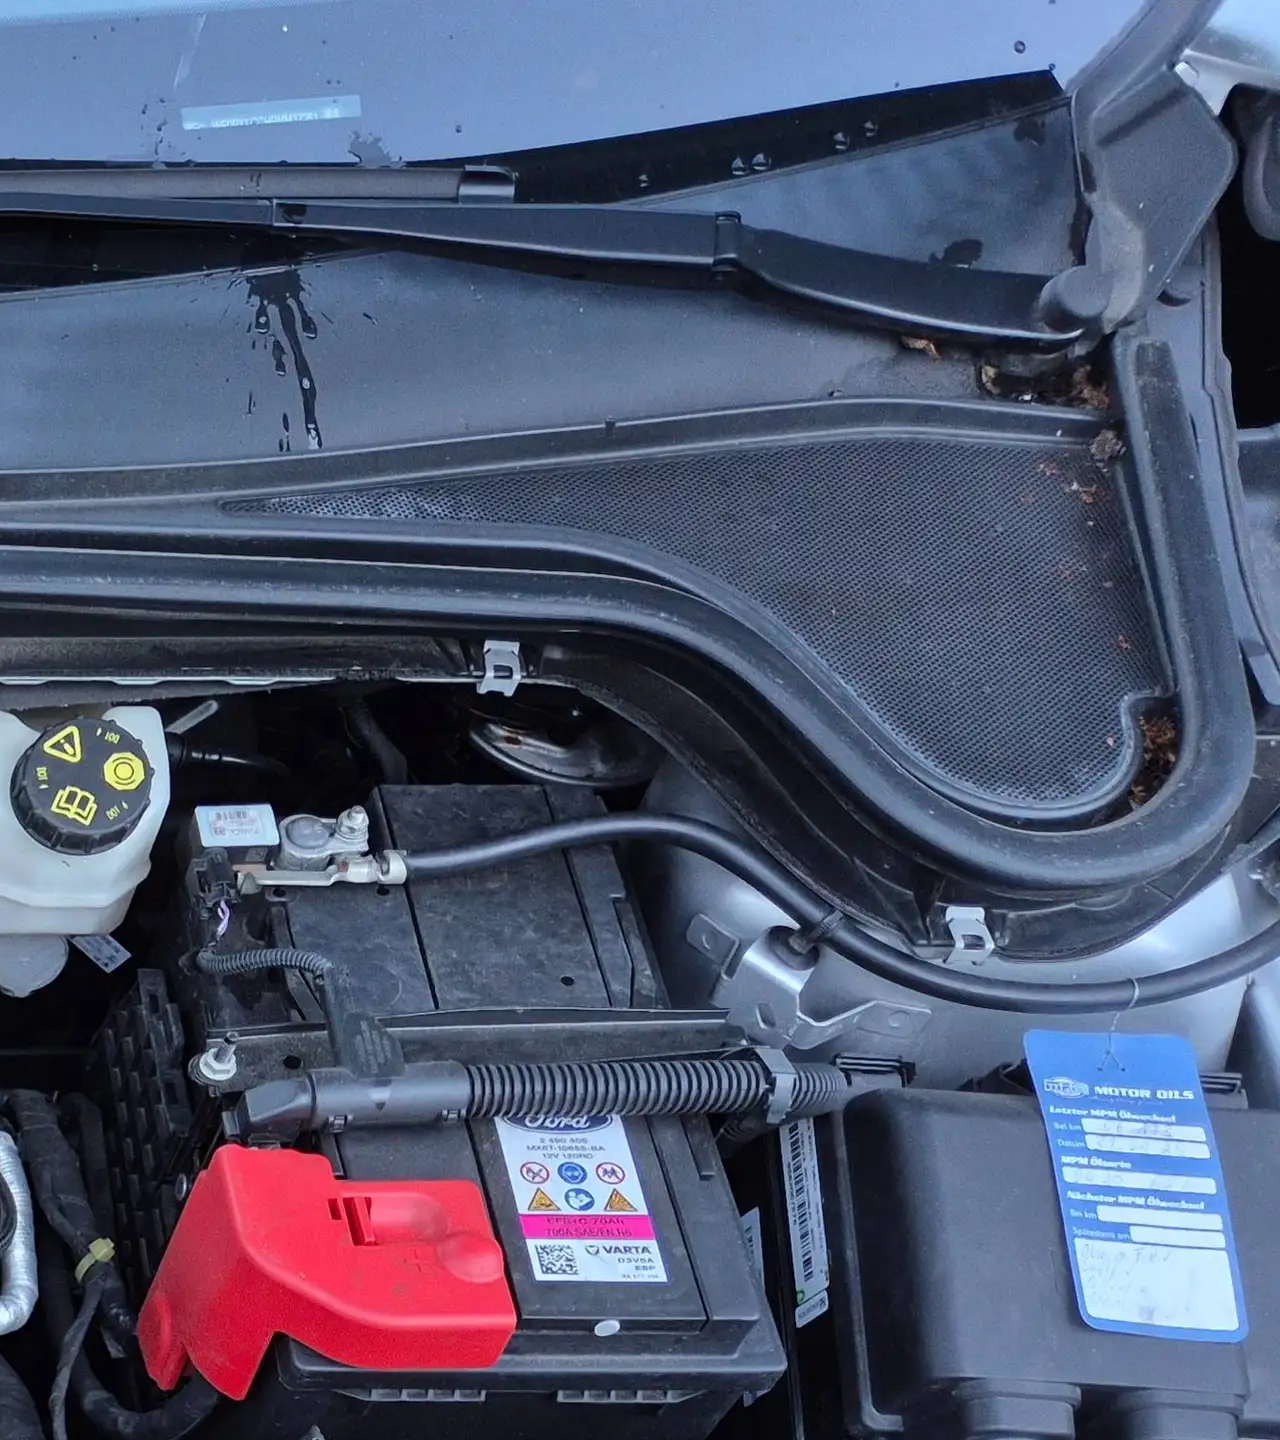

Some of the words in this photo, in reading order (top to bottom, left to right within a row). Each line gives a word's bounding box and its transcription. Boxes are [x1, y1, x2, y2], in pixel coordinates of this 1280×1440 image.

[1094, 1086, 1151, 1099] MOTOR
[1156, 1089, 1195, 1100] OILS
[1090, 1109, 1118, 1118] MPM
[1061, 1155, 1089, 1166] MPM
[601, 1245, 652, 1254] VARTA
